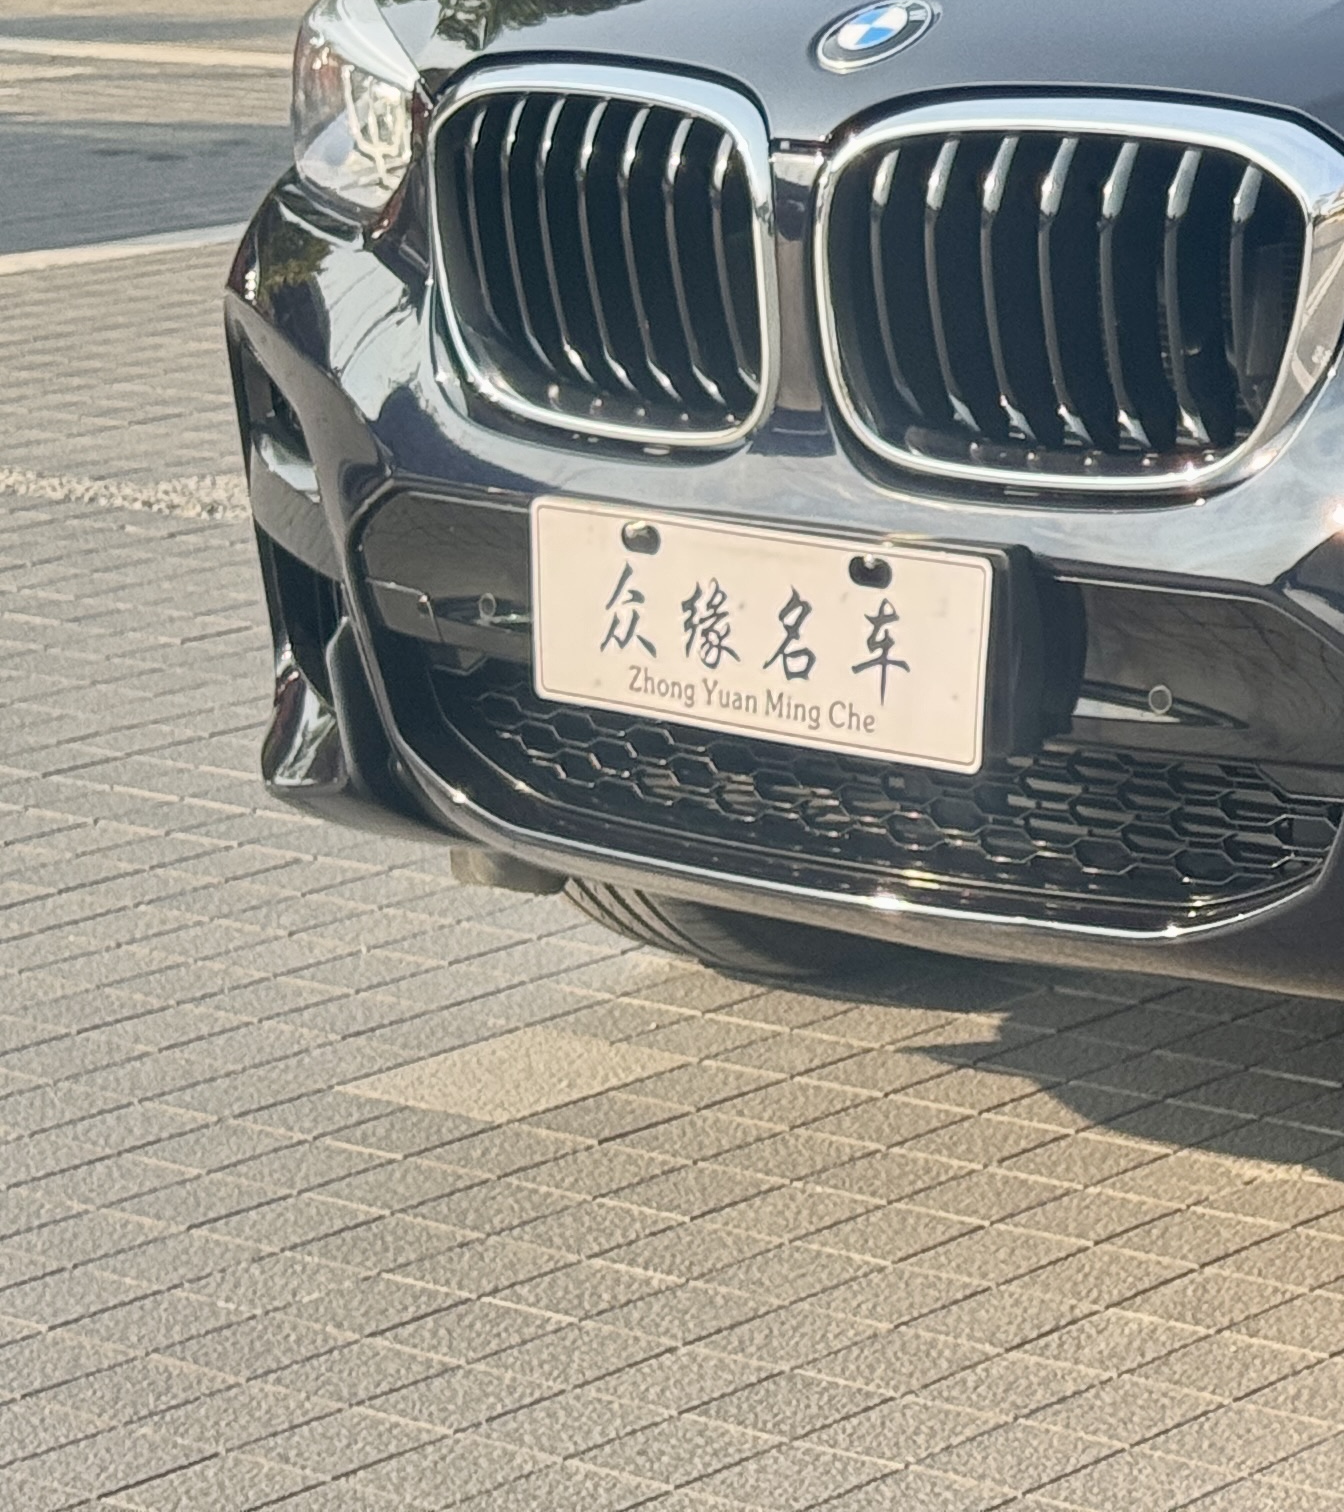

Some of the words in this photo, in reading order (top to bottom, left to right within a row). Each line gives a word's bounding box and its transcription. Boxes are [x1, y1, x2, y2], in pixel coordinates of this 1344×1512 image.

[599, 560, 911, 706] 众缘名车
[629, 664, 696, 709] Zhong
[702, 677, 758, 715] Yuan
[764, 688, 821, 731] Ming
[829, 700, 876, 734] Che
